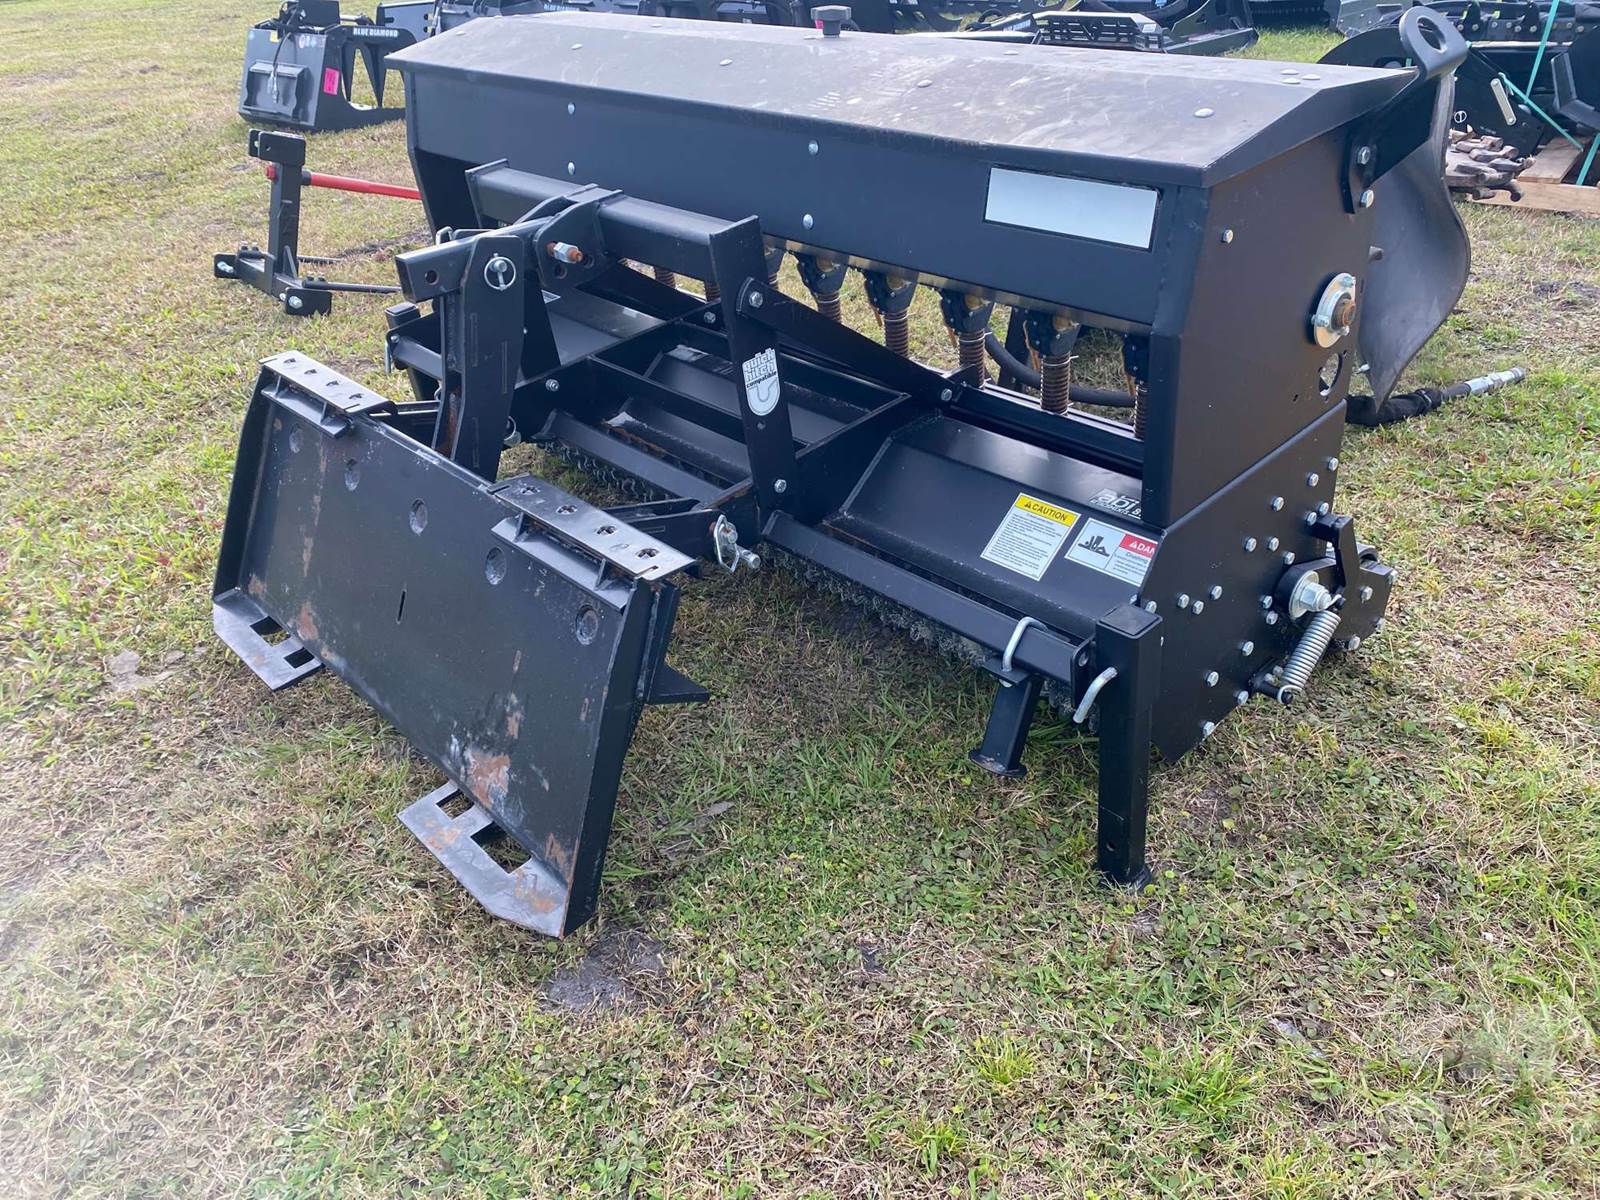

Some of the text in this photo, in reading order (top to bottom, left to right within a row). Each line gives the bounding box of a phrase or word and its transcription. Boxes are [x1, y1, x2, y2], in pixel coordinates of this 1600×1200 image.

[353, 27, 399, 38] BLUE DIAMOND
[743, 348, 776, 373] quick
[744, 359, 778, 383] hitch
[746, 370, 777, 389] compatible
[1032, 503, 1067, 521] CAUTION
